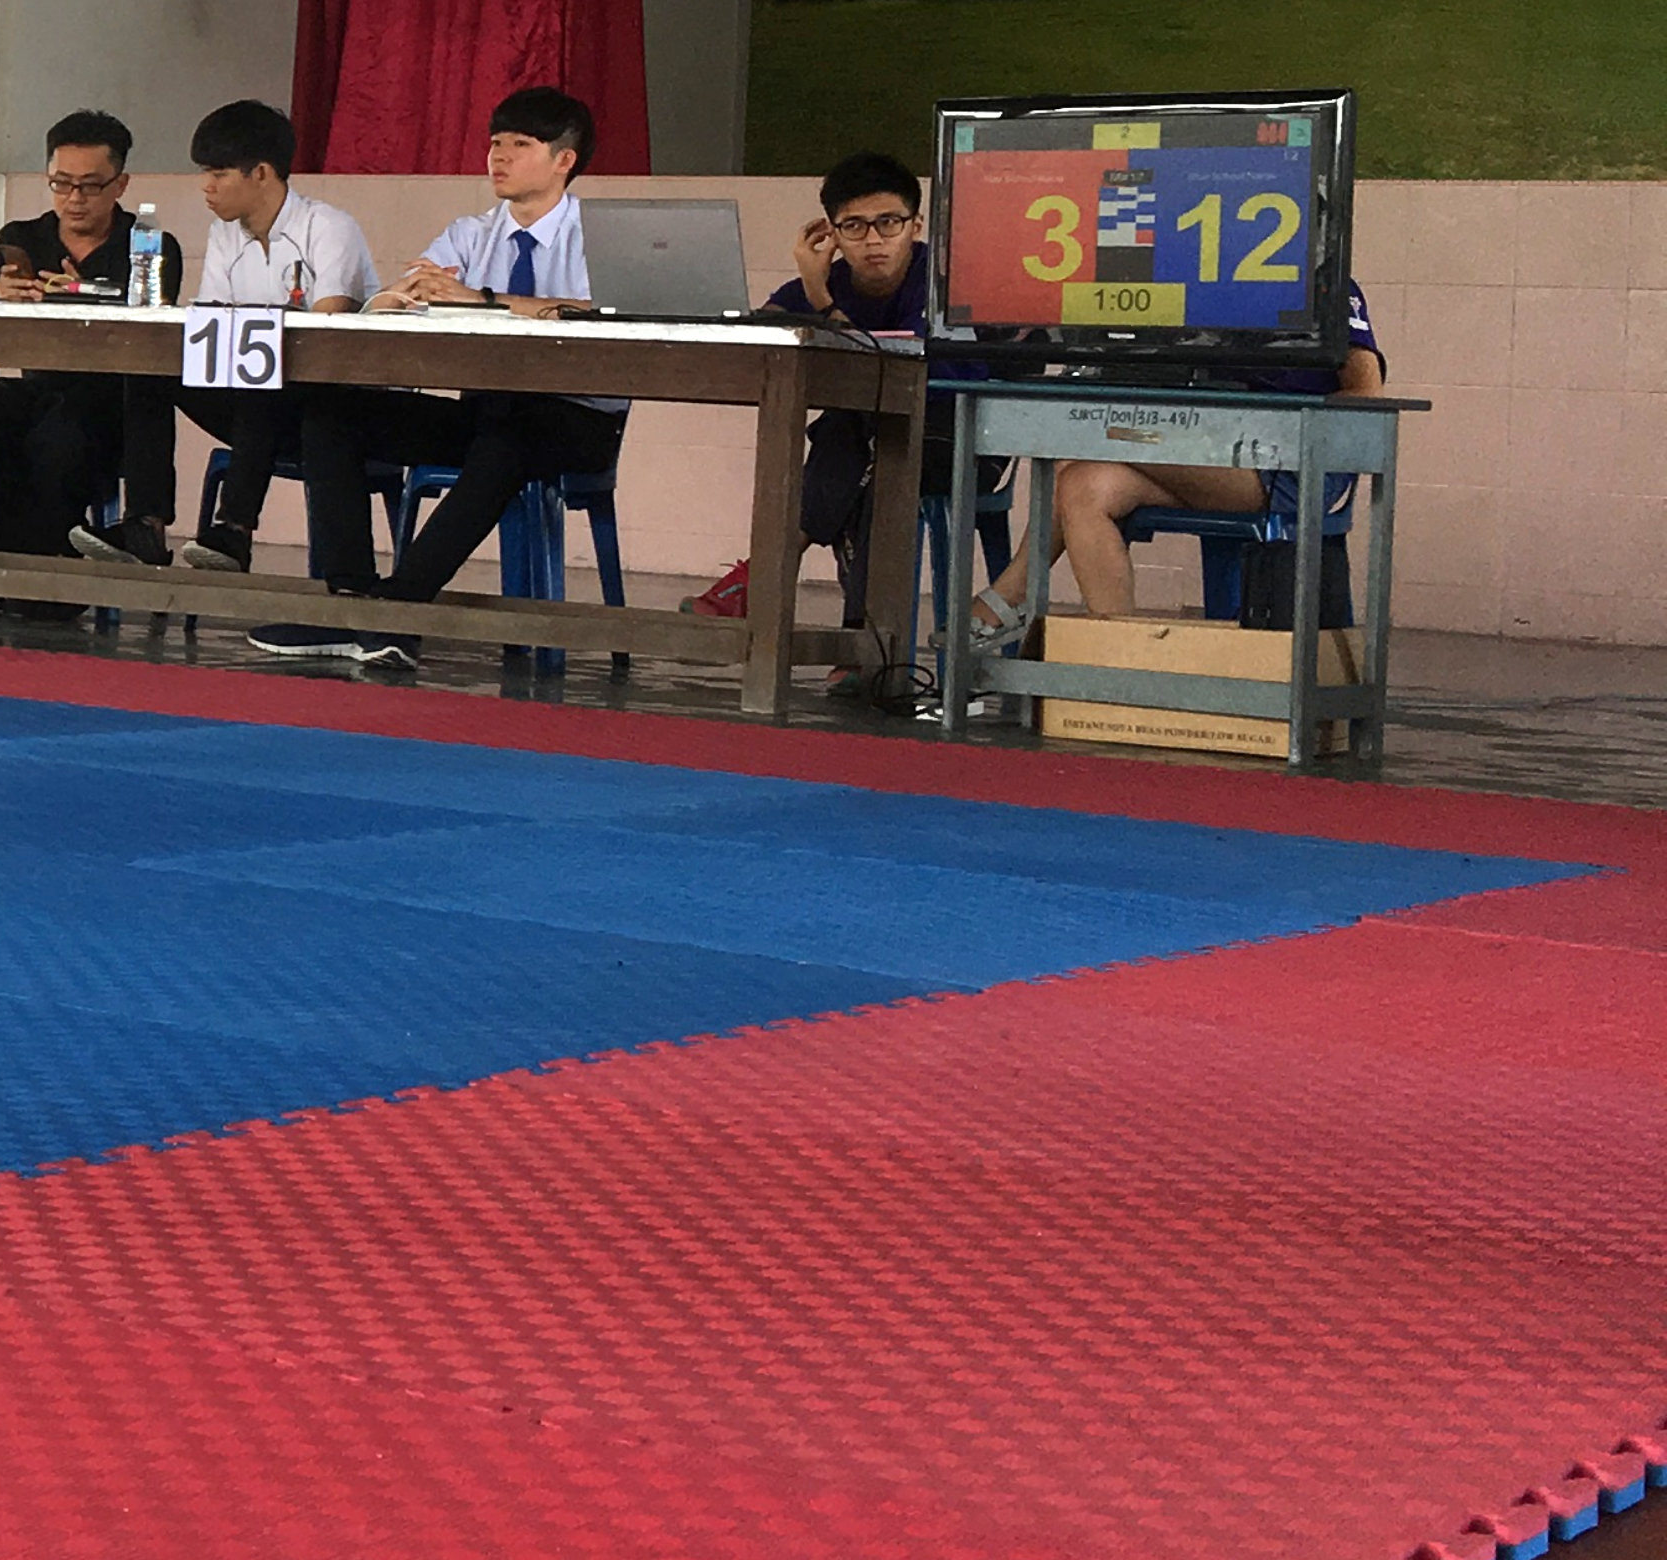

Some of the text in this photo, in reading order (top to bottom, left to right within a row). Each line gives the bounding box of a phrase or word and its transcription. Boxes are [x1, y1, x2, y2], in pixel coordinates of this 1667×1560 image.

[1022, 194, 1083, 282] 3
[1176, 192, 1301, 283] 12
[1093, 288, 1151, 312] 1:00
[189, 318, 276, 385] 15
